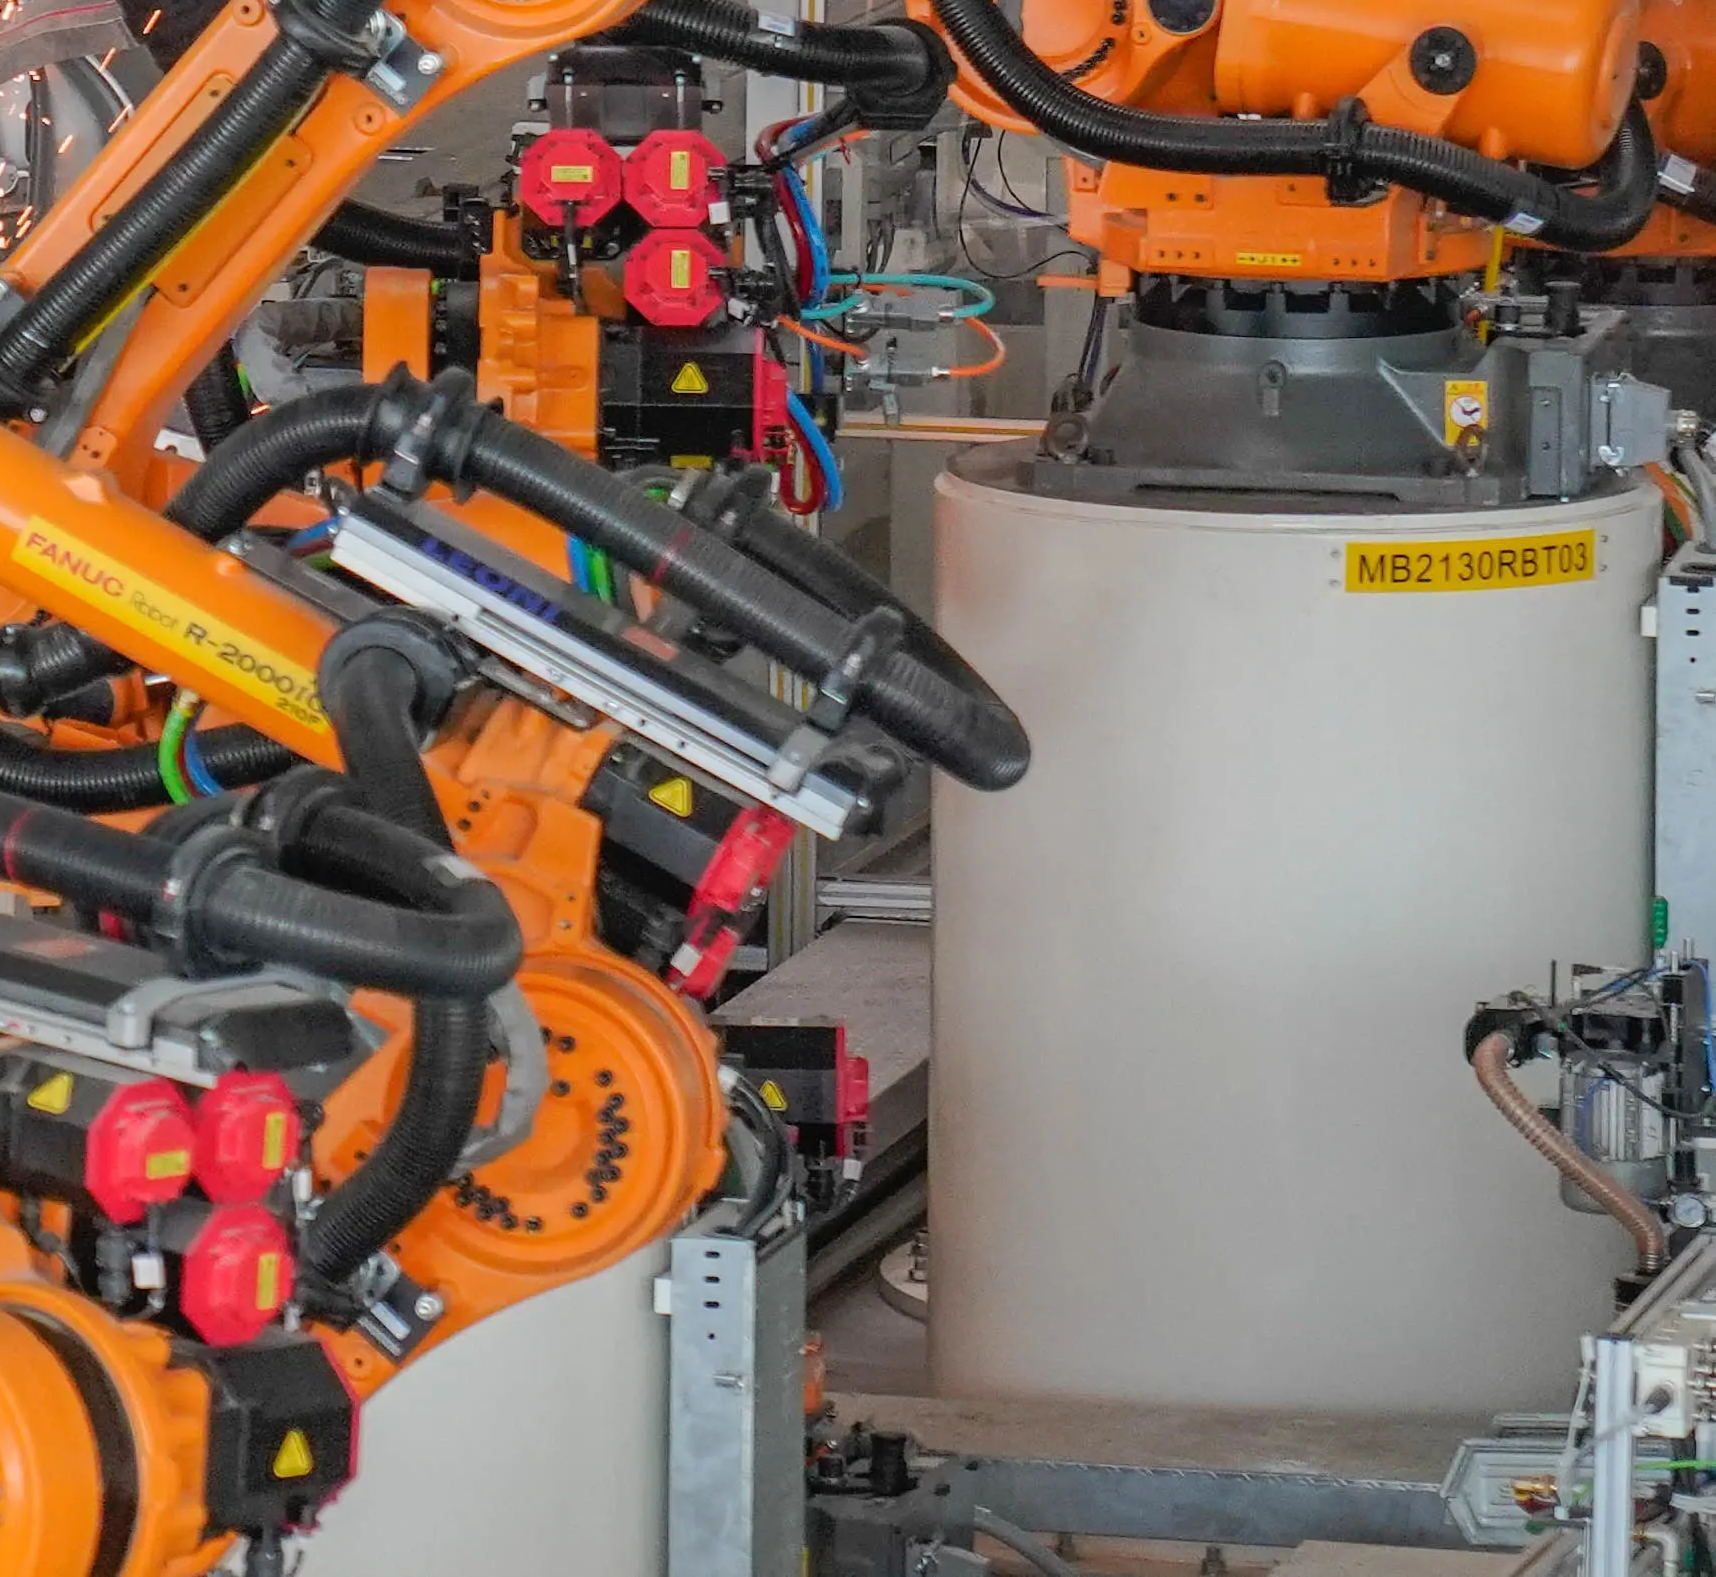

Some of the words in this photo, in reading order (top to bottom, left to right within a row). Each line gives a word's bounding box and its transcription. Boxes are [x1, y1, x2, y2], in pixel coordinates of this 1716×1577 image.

[25, 531, 125, 597] FANUC
[129, 590, 180, 631] Robot
[1358, 542, 1587, 584] MB2130RBT03
